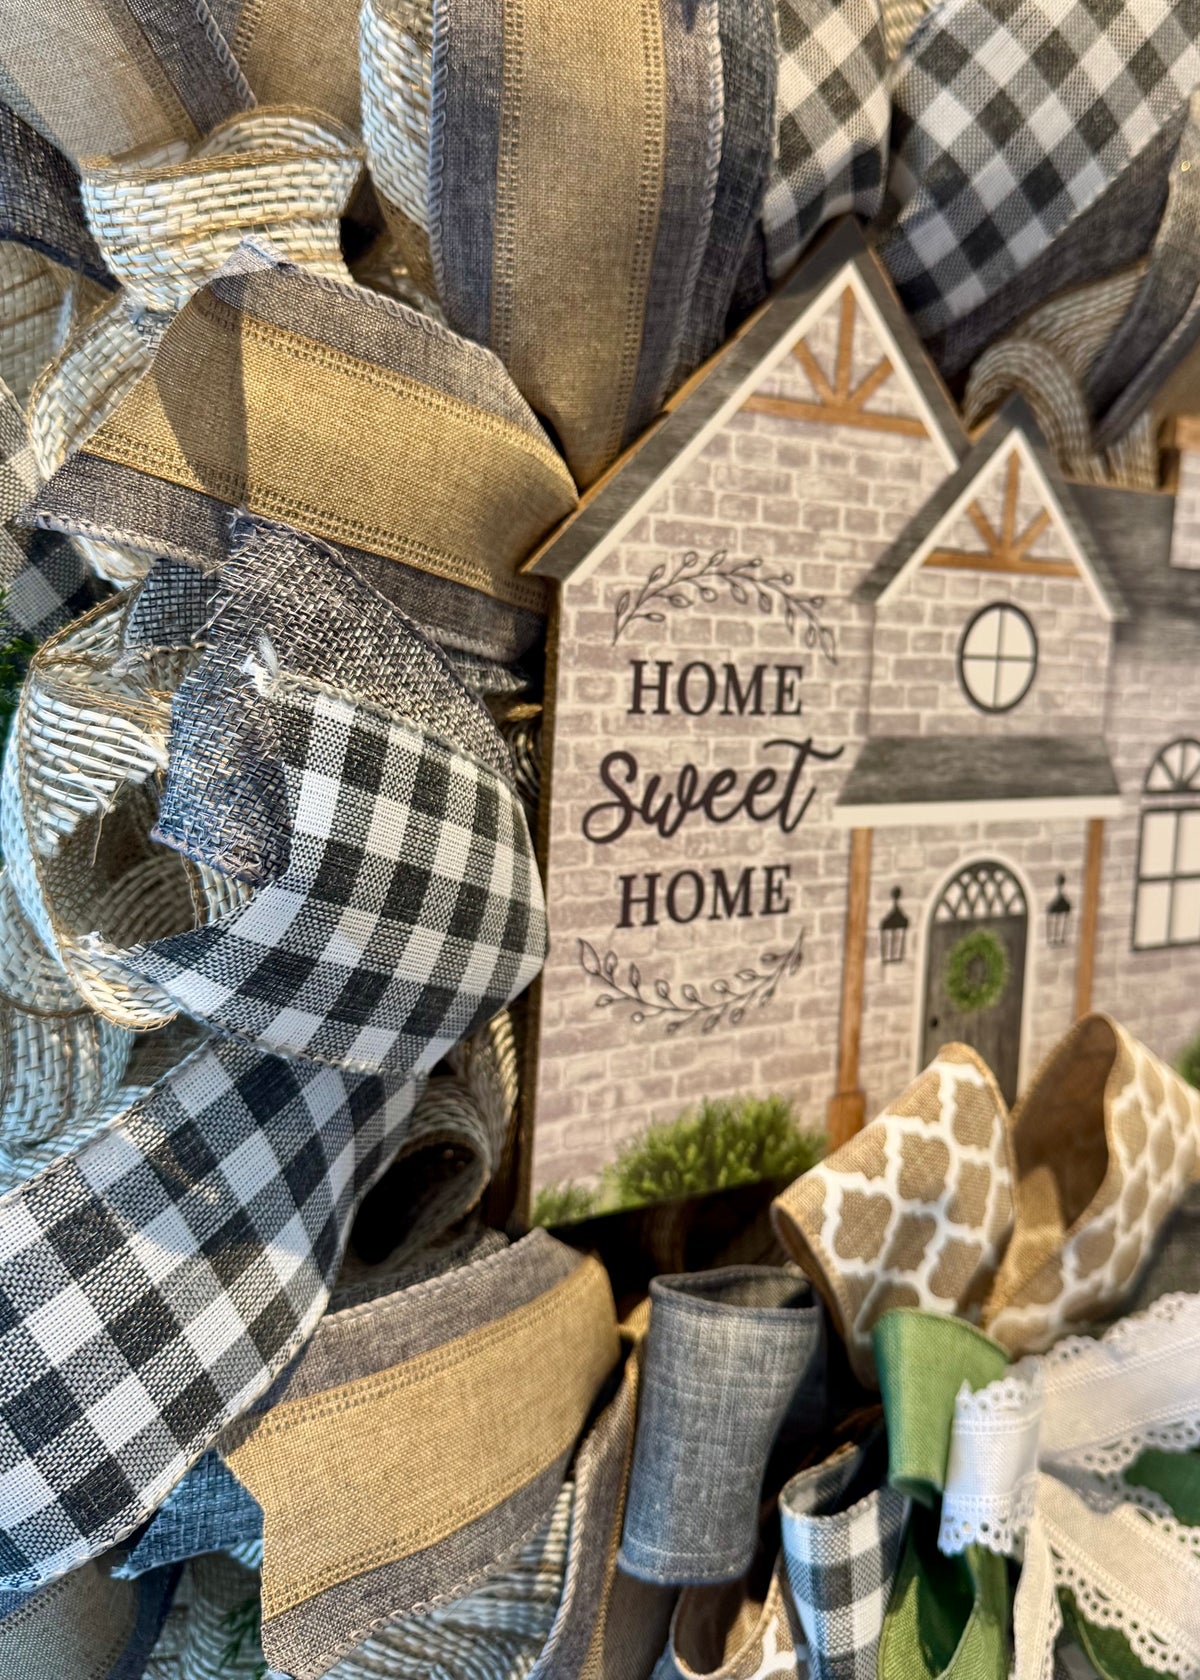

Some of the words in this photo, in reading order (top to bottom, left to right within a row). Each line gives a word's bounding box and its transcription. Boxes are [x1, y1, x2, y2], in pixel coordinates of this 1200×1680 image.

[627, 659, 804, 717] HOME
[582, 737, 845, 845] Sweet
[615, 863, 792, 929] HOME
